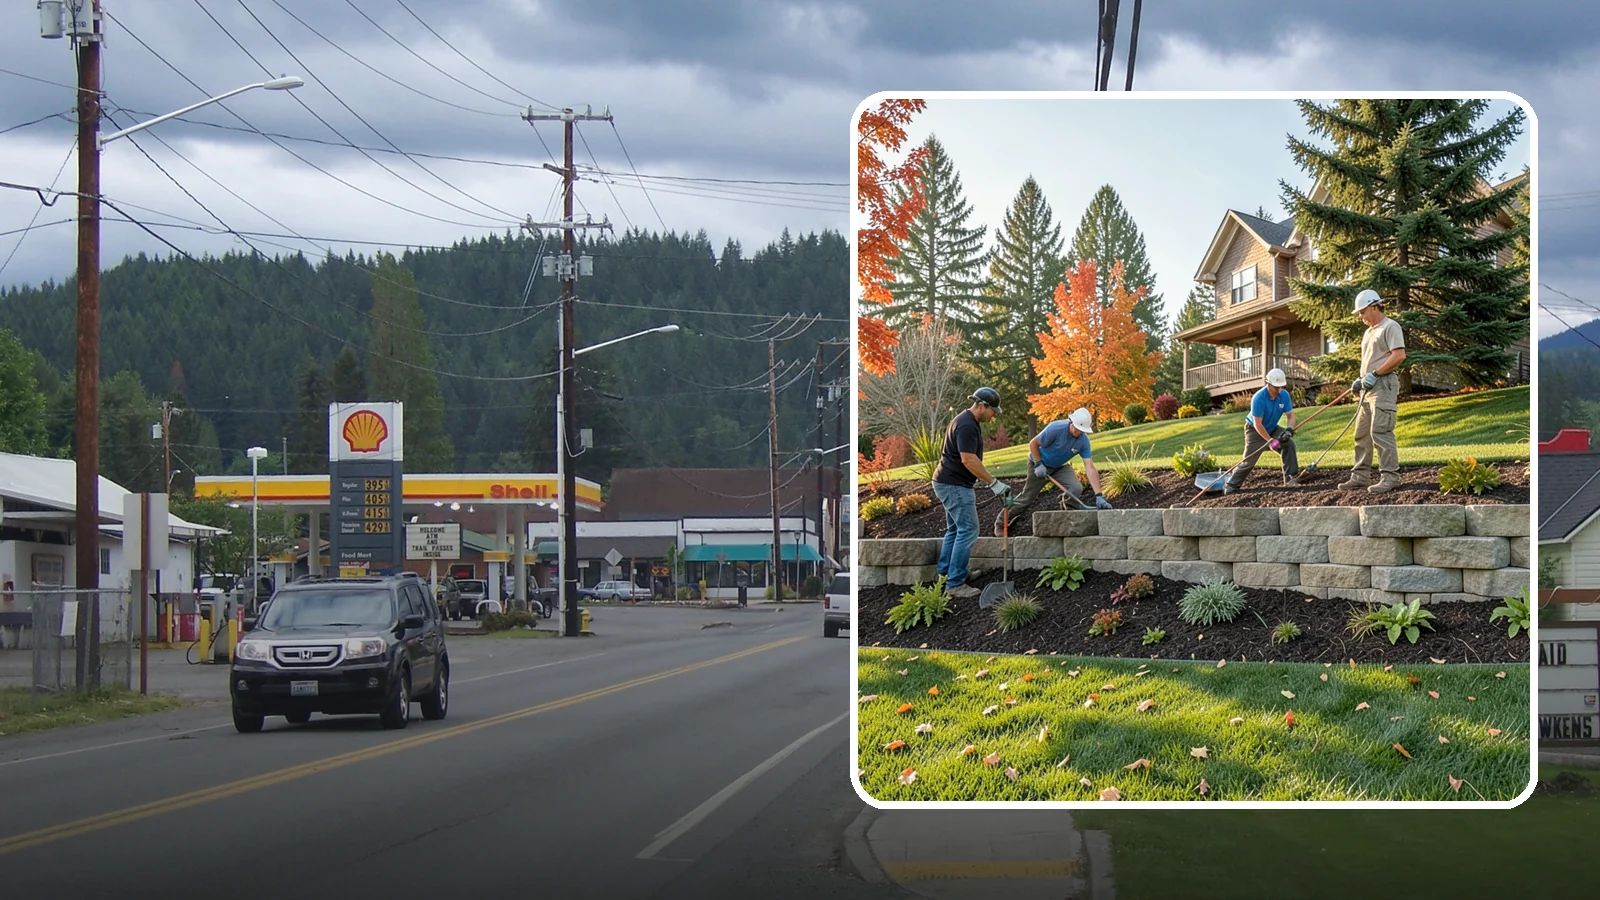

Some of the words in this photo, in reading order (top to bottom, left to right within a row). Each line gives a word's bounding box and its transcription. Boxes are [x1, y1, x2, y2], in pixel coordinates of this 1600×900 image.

[366, 480, 384, 490] 395
[490, 484, 547, 498] Shell
[366, 494, 384, 504] 405
[366, 508, 384, 518] 415
[366, 522, 384, 532] 429
